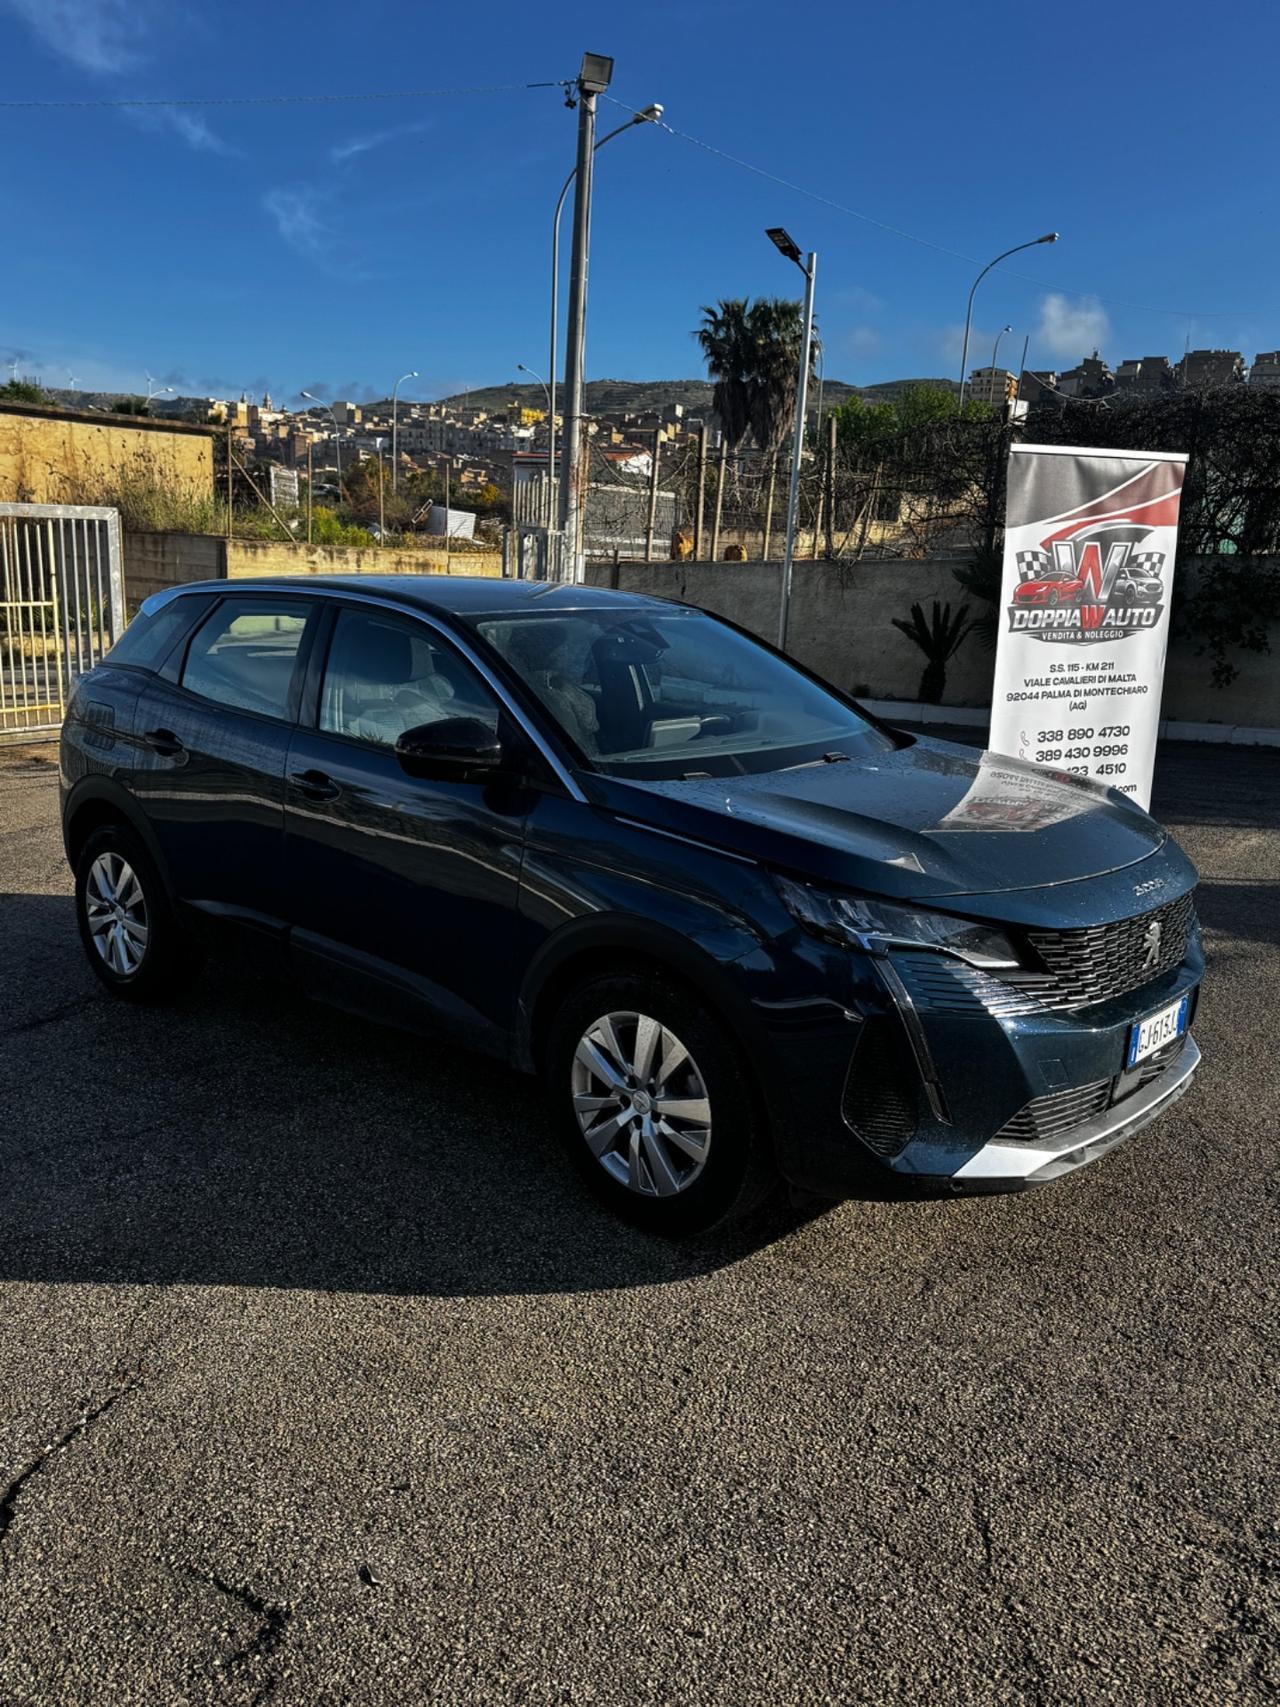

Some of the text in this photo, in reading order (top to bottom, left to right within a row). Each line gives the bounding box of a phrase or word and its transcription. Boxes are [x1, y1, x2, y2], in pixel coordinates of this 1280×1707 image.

[1042, 630, 1124, 640] VENDITA & NOLEGGIO
[1067, 663, 1080, 672] 115
[1085, 662, 1099, 671] KM
[1100, 661, 1115, 670] 211
[1023, 673, 1136, 687] VIALE CAVALIERI DI MALTA
[1006, 685, 1148, 702] 92044 PALMA DI MONTECHIARO
[1069, 699, 1087, 711] (AG)
[1037, 725, 1130, 743] 338 890 4730
[1035, 744, 1128, 762] 389 430 9996
[1066, 765, 1089, 777] 23
[1096, 762, 1127, 775] 4510
